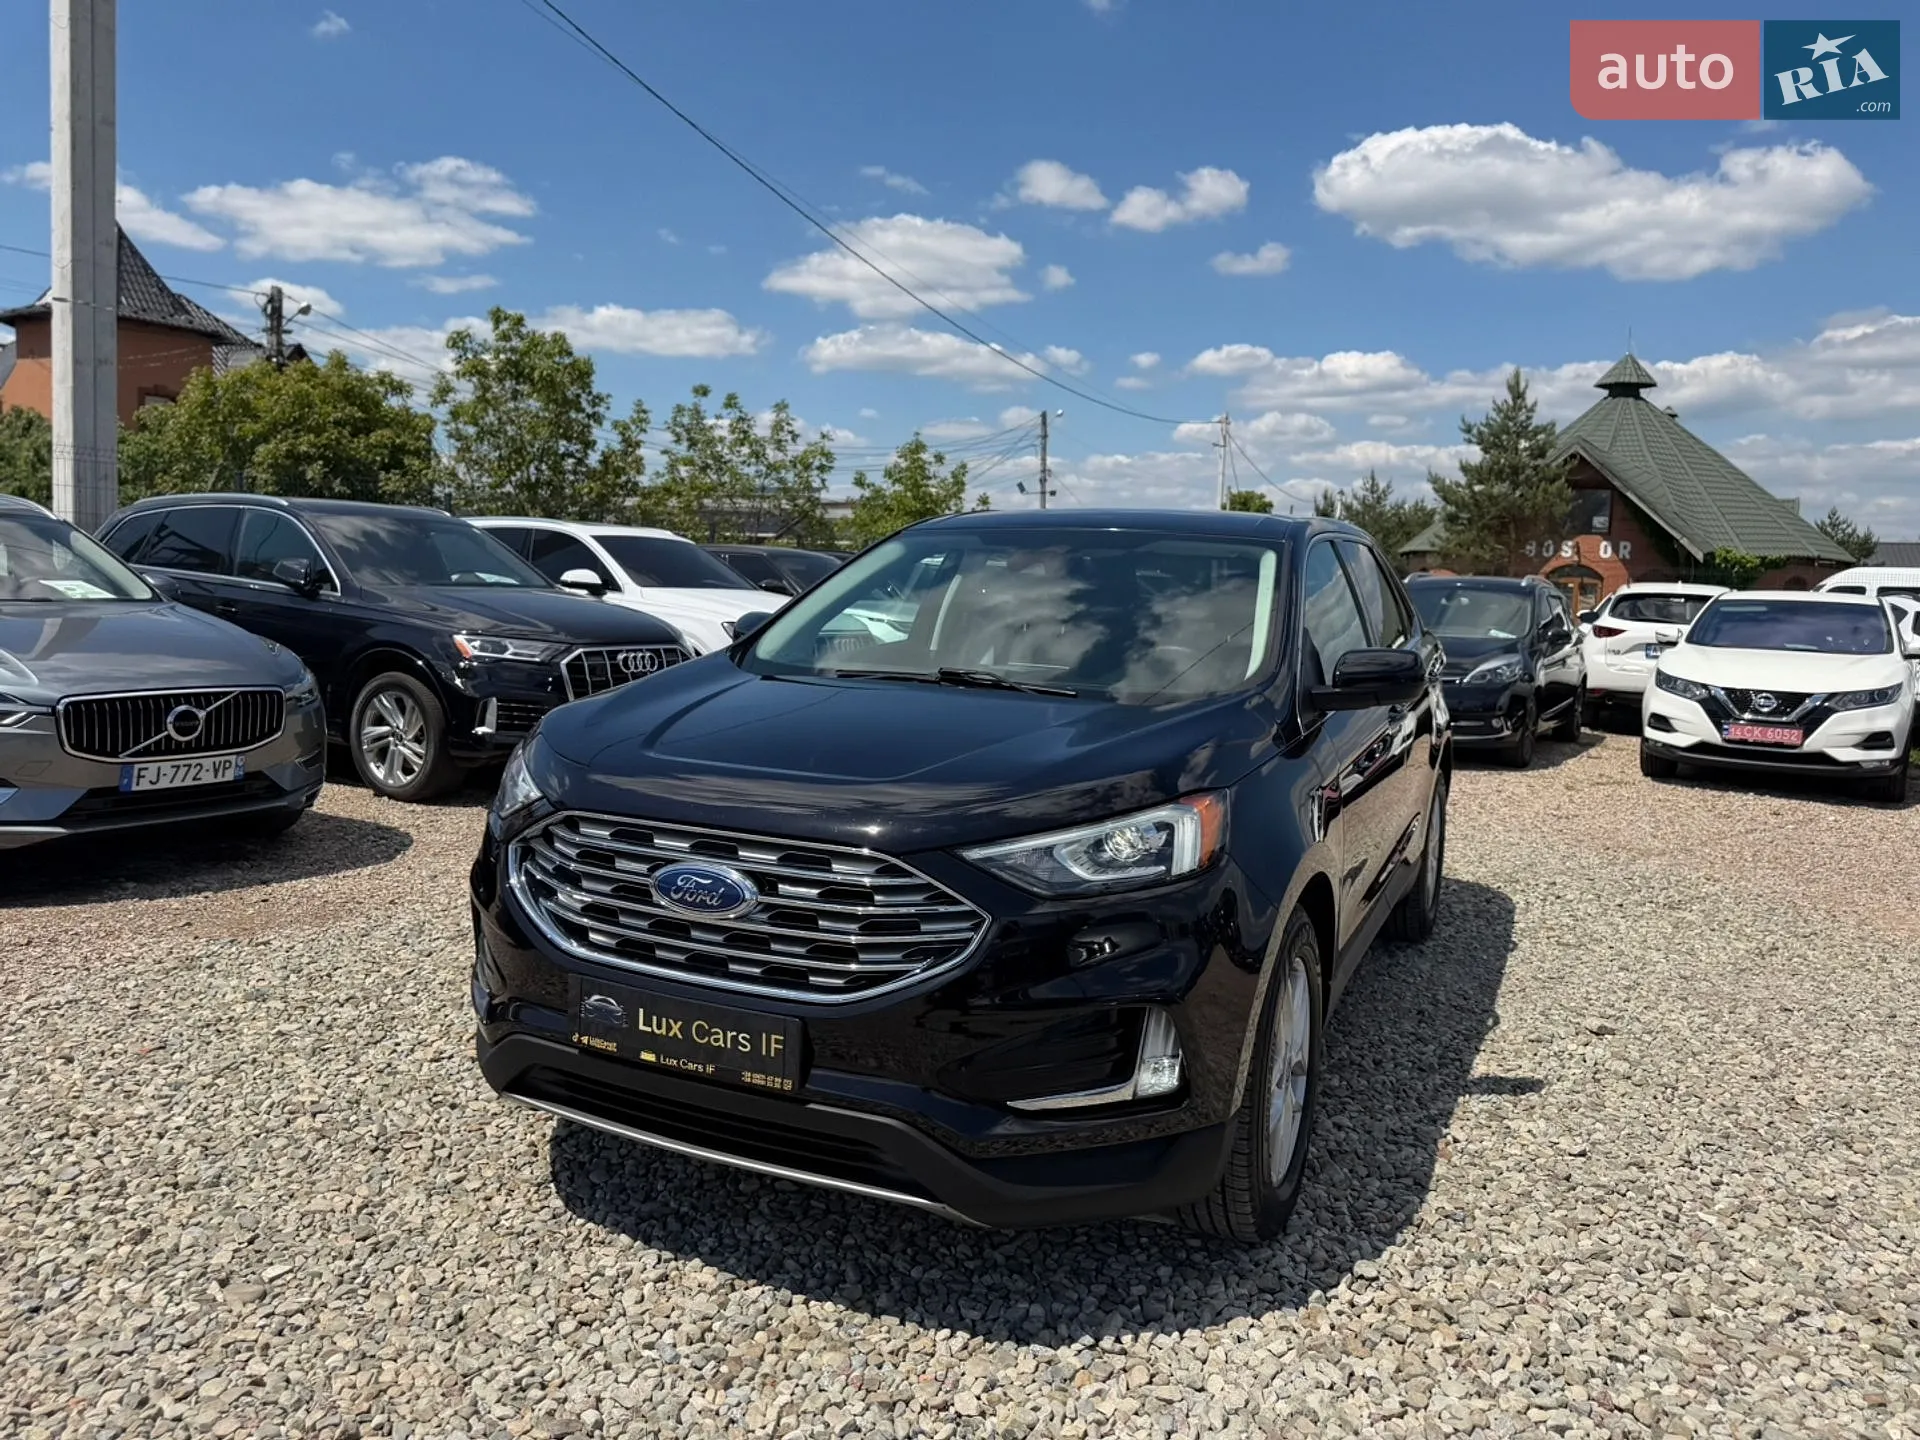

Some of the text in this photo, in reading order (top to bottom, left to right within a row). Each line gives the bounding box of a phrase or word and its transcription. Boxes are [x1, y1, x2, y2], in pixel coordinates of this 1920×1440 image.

[1766, 727, 1799, 741] 6052
[135, 758, 233, 787] FJ-772-VP
[670, 874, 725, 906] Ford
[638, 1007, 785, 1058] Lux Cars IF
[659, 1053, 679, 1068] Lux
[679, 1058, 704, 1073] Cars
[705, 1063, 716, 1075] IF
